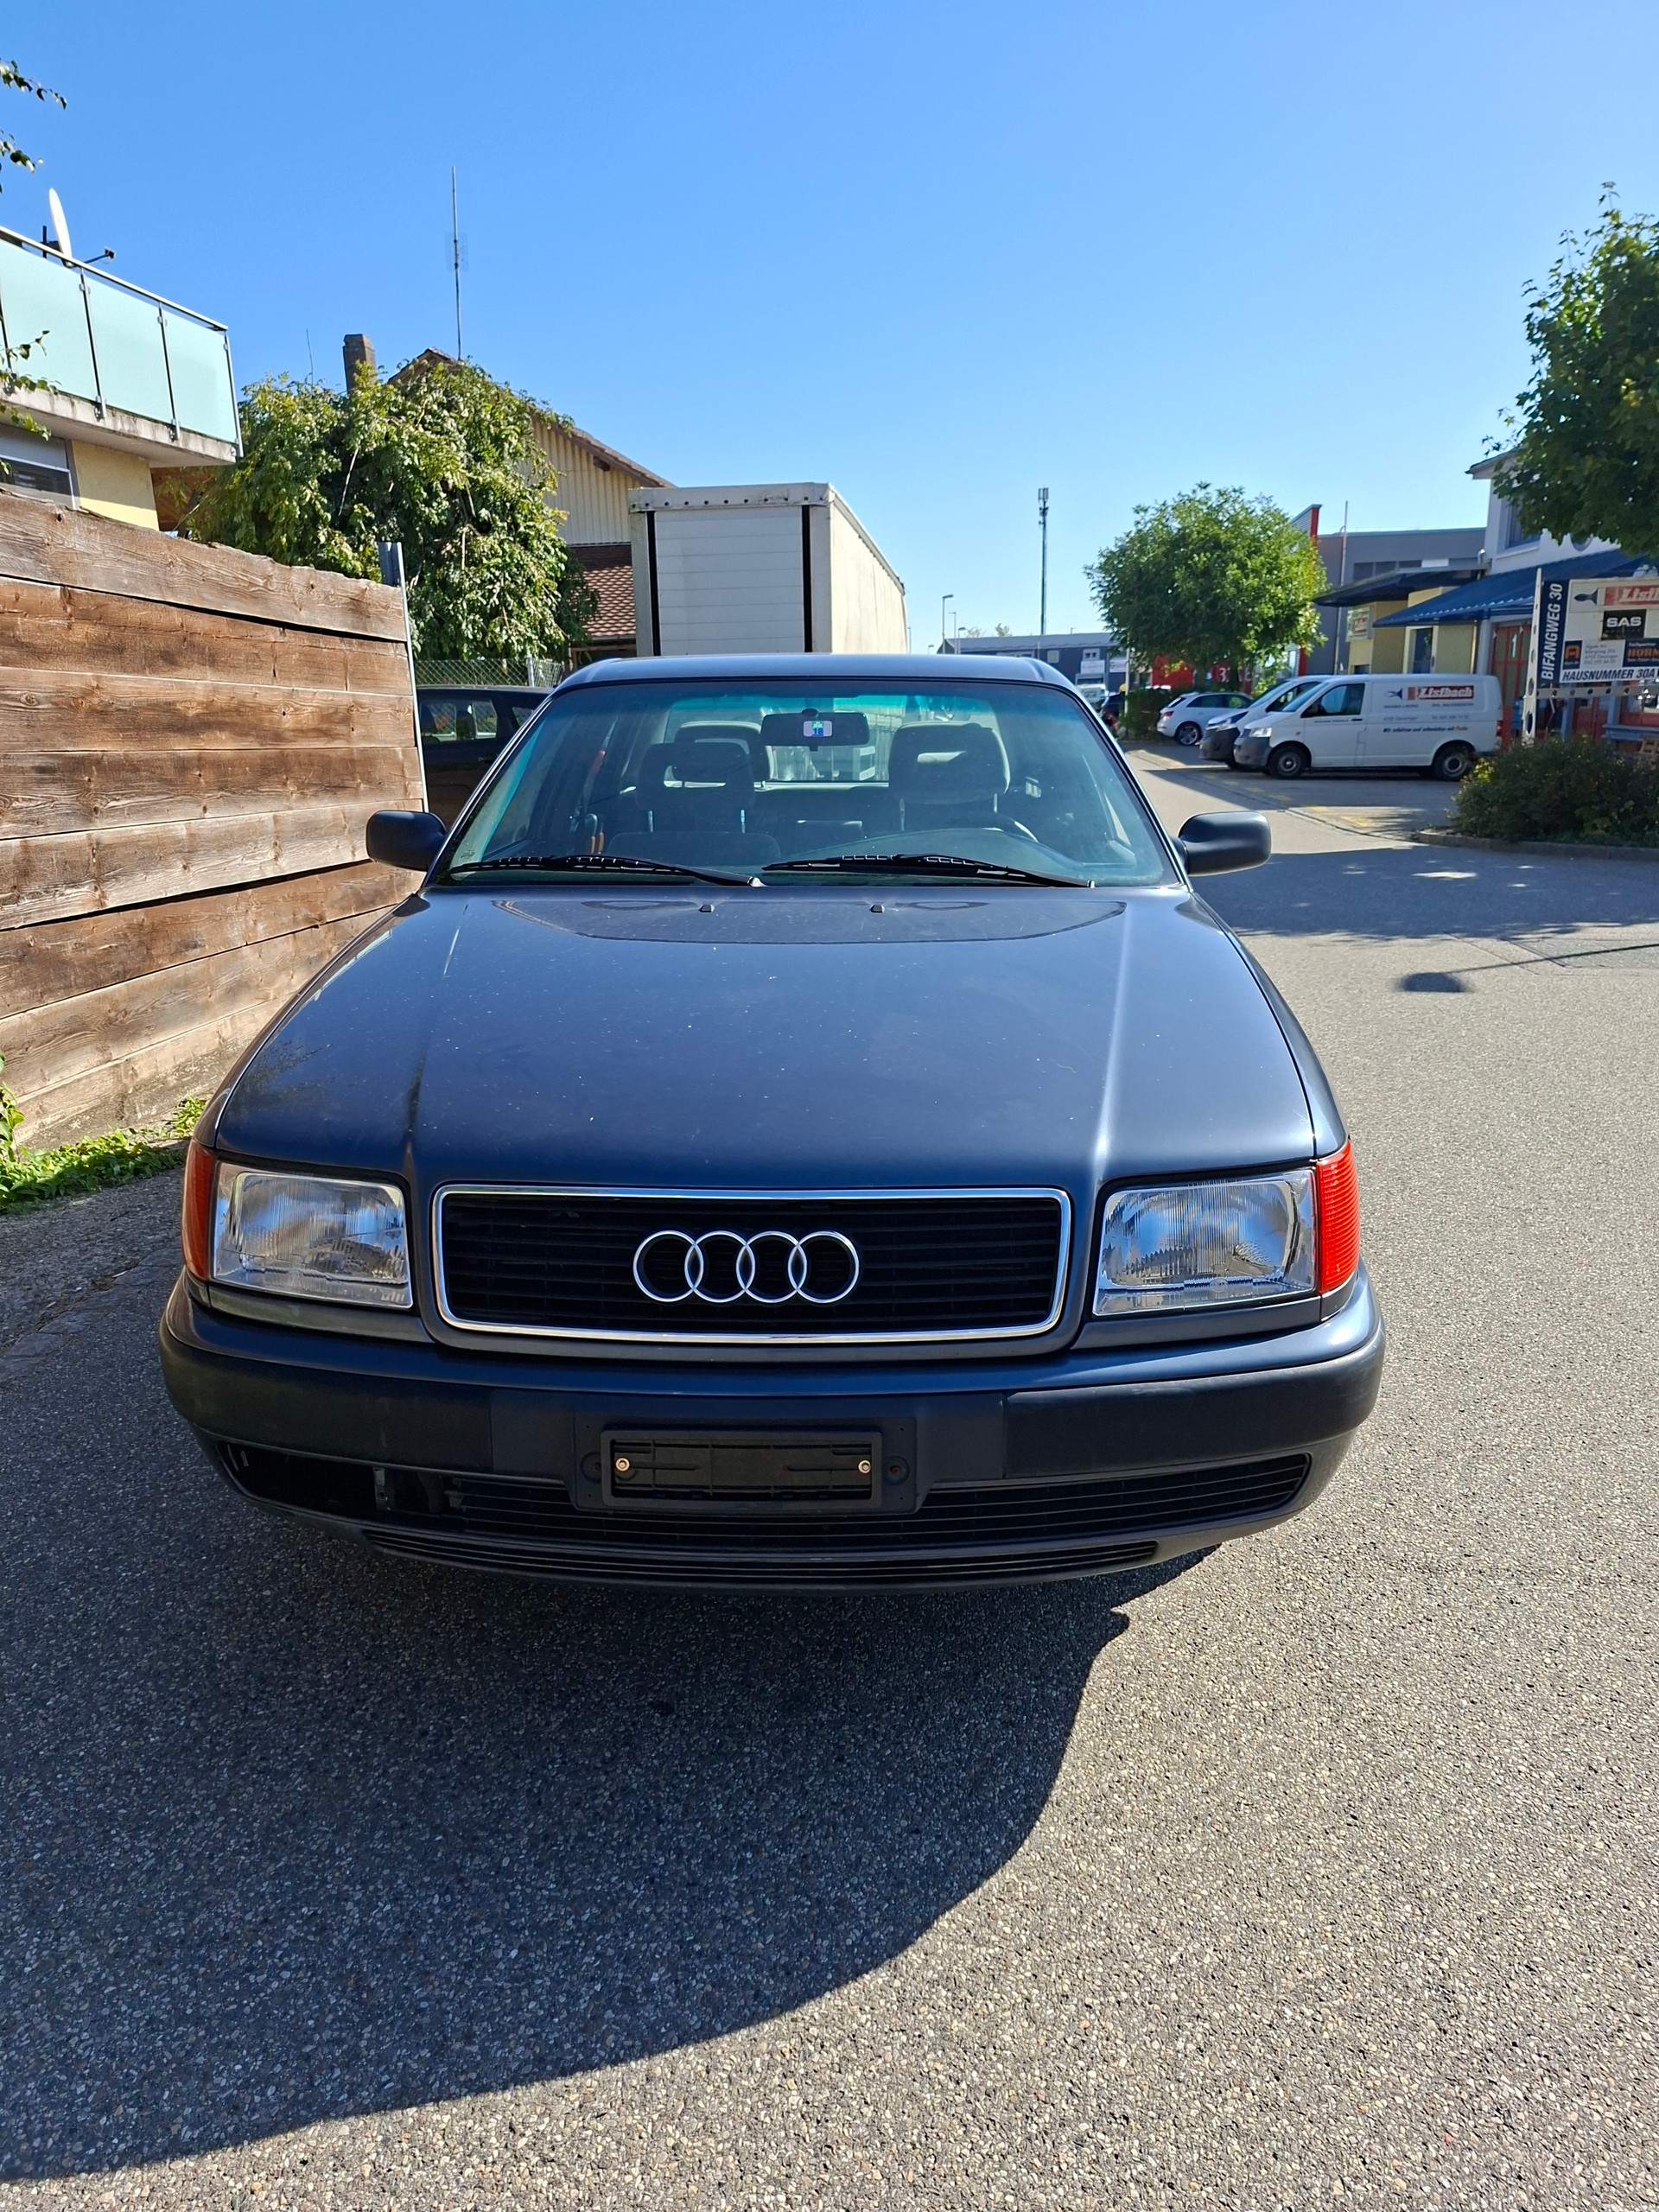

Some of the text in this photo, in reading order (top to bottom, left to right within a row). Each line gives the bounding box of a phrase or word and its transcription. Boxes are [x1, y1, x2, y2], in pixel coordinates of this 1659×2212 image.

[1606, 616, 1642, 627] SAS
[1541, 583, 1563, 680] BIFANGWEG 30
[1562, 668, 1656, 681] HAUSNUMMER 30A
